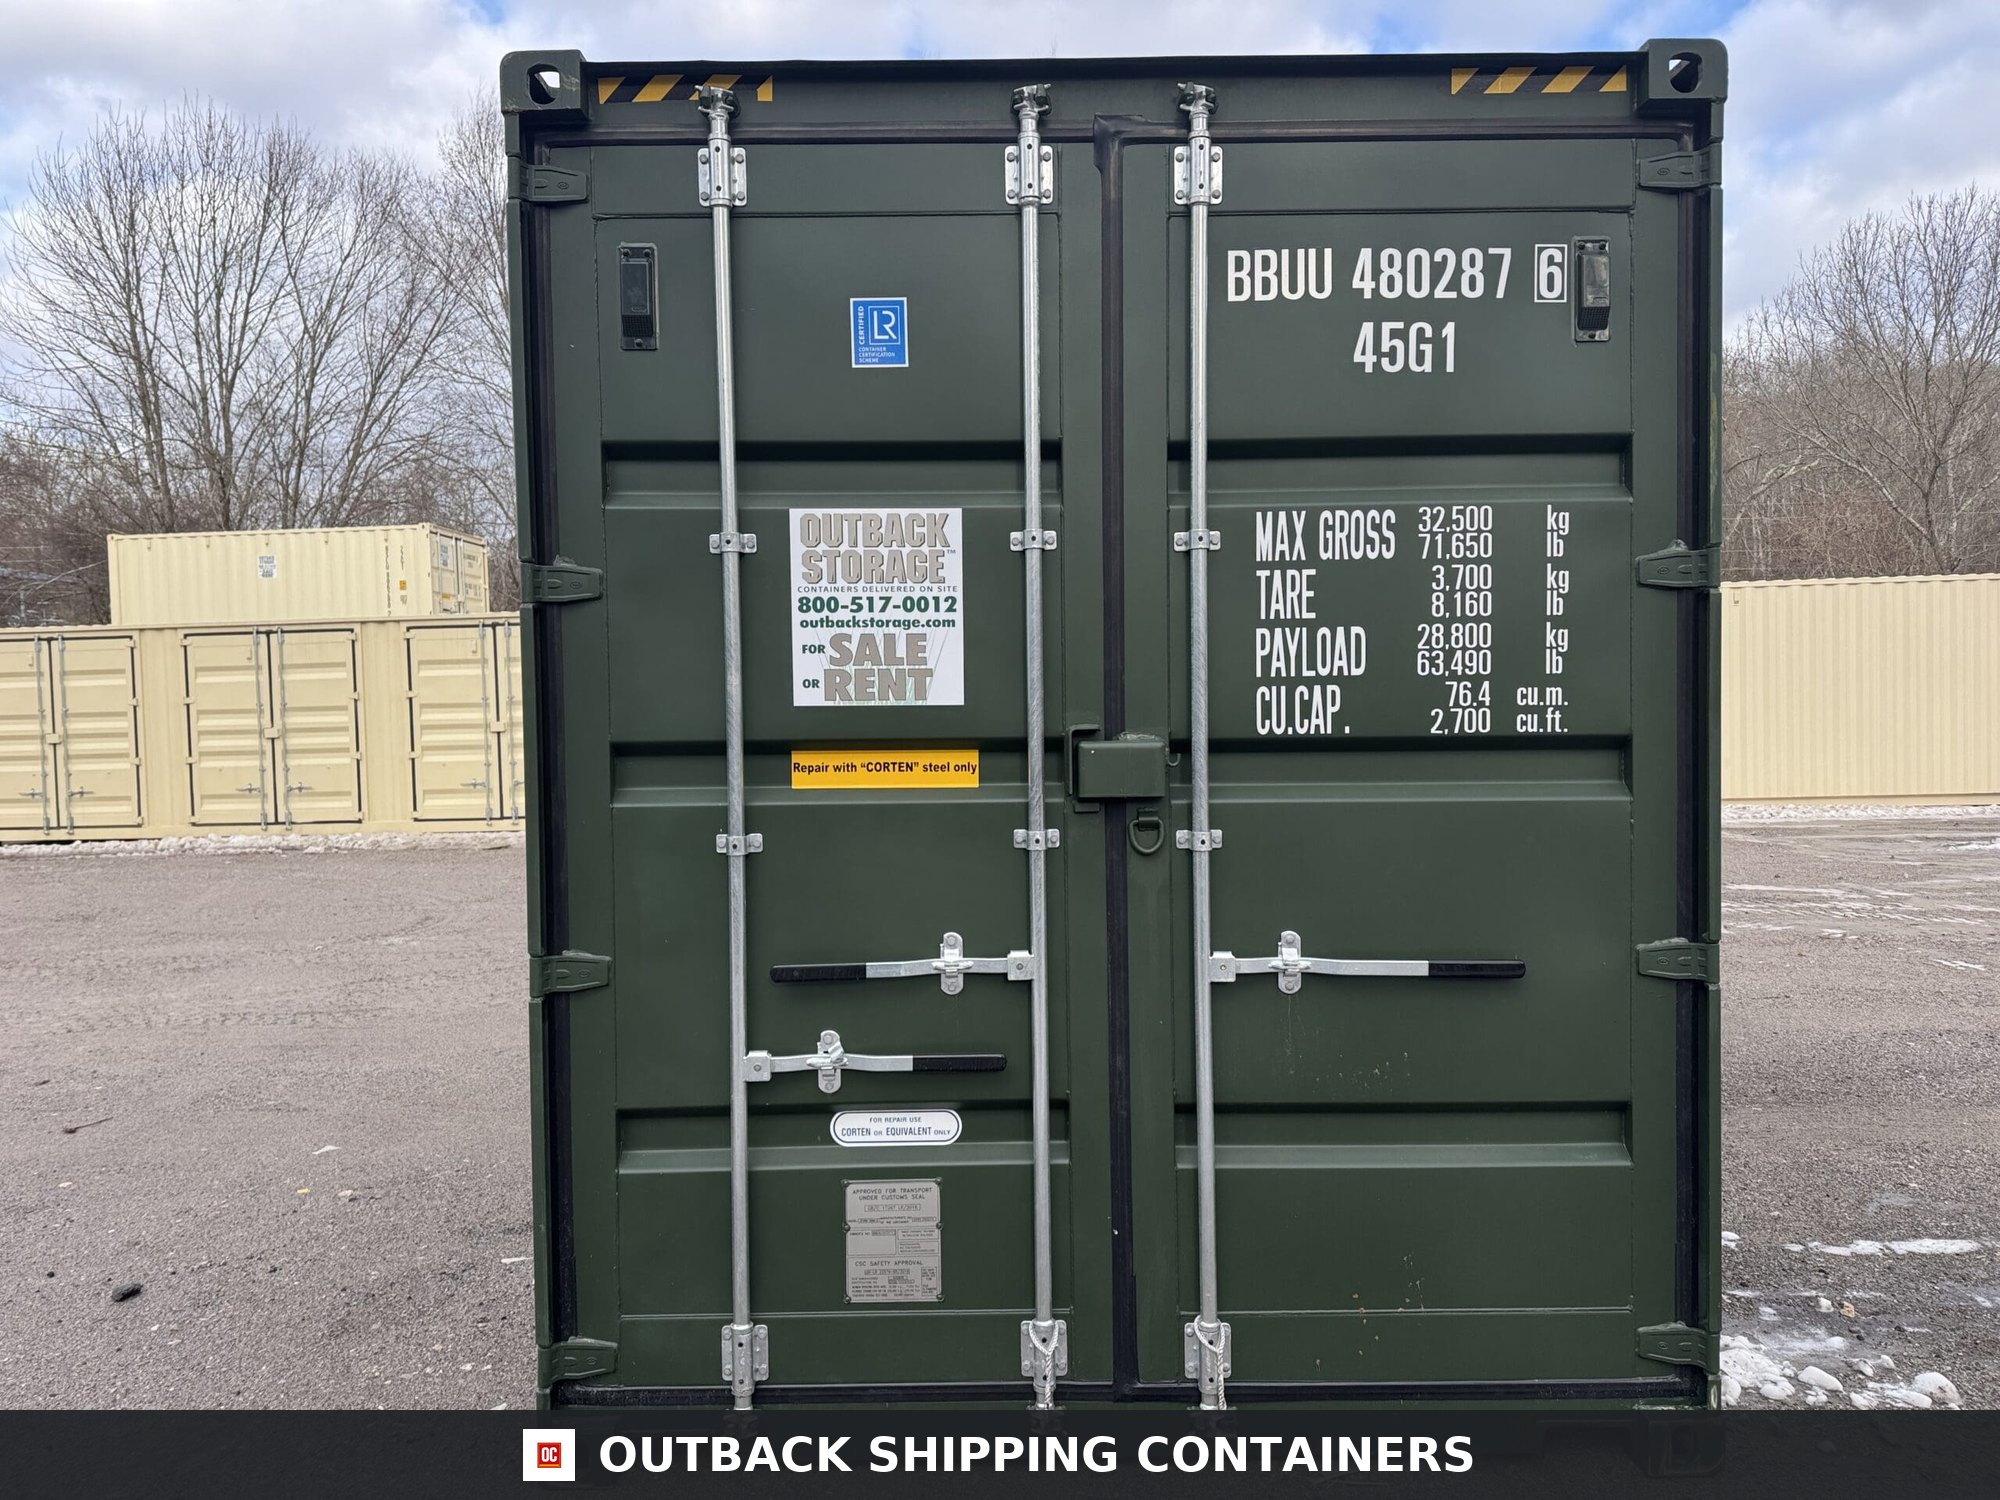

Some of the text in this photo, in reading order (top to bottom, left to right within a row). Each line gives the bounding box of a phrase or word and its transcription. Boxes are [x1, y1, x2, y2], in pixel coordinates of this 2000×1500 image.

[1228, 248, 1564, 301] BBUU 480287 6
[874, 310, 897, 339] LR
[1354, 322, 1455, 372] 45G1
[800, 513, 950, 548] OUTBACK
[1255, 505, 1570, 562] MAX GROSS 32,500 kg
[1421, 532, 1564, 559] 71,650 lb
[801, 550, 945, 584] STORAGE
[798, 596, 957, 613] 800-517-0012
[1256, 563, 1569, 619] TARE 3,700 kg
[1431, 590, 1563, 618] 8,160 lb
[800, 616, 956, 630] outbackstorage.com
[802, 633, 927, 666] FOR SALE
[1255, 622, 1568, 678] PAYLOAD 28,800 kg
[1417, 649, 1563, 676] 63,490 lb
[802, 668, 933, 701] OR RENT
[1255, 681, 1568, 735] CU.CAP. 76.4 cu.m.
[1430, 708, 1568, 734] 2,700 cu.ft.
[793, 762, 977, 775] Repair with “CORTEN” steel only
[841, 1128, 870, 1136] CORTEN
[886, 1127, 931, 1136] EQUIVALENT
